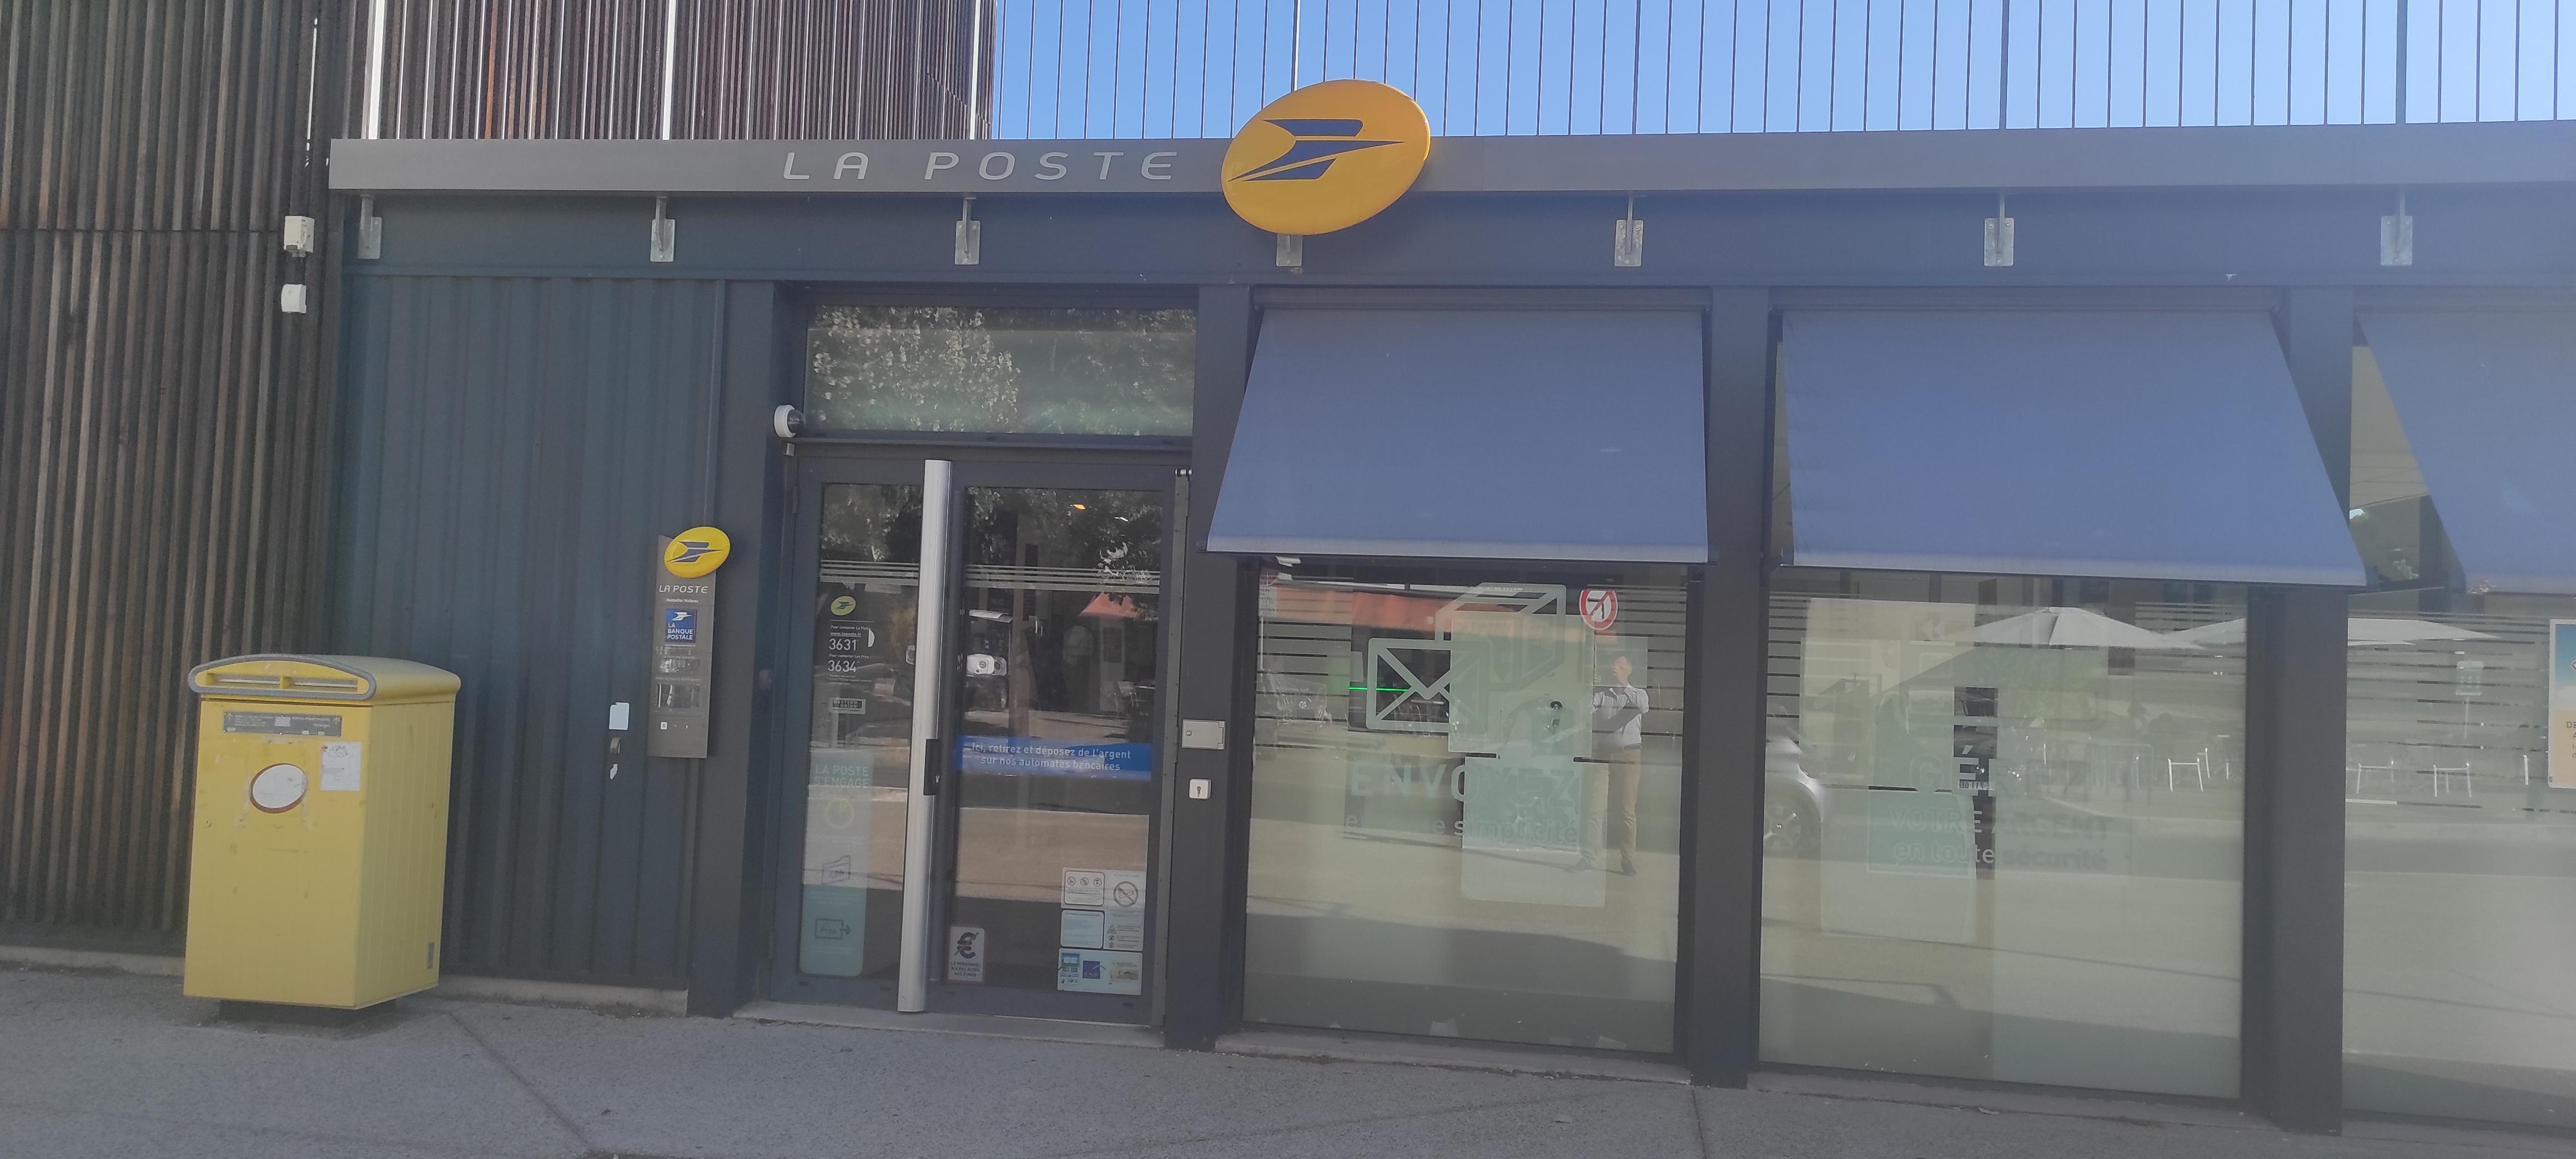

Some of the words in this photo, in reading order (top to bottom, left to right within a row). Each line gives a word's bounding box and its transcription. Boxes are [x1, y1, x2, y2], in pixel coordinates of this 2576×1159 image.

[783, 152, 869, 180] LA
[924, 152, 1177, 181] POSTE
[658, 584, 671, 593] LA
[672, 585, 708, 594] POSTE
[828, 638, 857, 651] 3631
[828, 659, 857, 673] 3634
[972, 743, 987, 752] Ici,
[988, 744, 1021, 754] retirez
[1024, 746, 1033, 754] et
[1036, 747, 1075, 759] déposez
[1078, 748, 1090, 757] de
[1093, 748, 1131, 760] l'argent
[815, 763, 829, 774] LA
[832, 765, 869, 777] POSTE
[980, 756, 998, 765] sur
[1019, 758, 1070, 768] automates
[1073, 760, 1121, 772] bancaires
[1350, 764, 1576, 808] ENVOYEZ
[1888, 805, 1983, 834] VOTRE
[1893, 841, 1926, 861] en
[1931, 840, 1995, 864] toute
